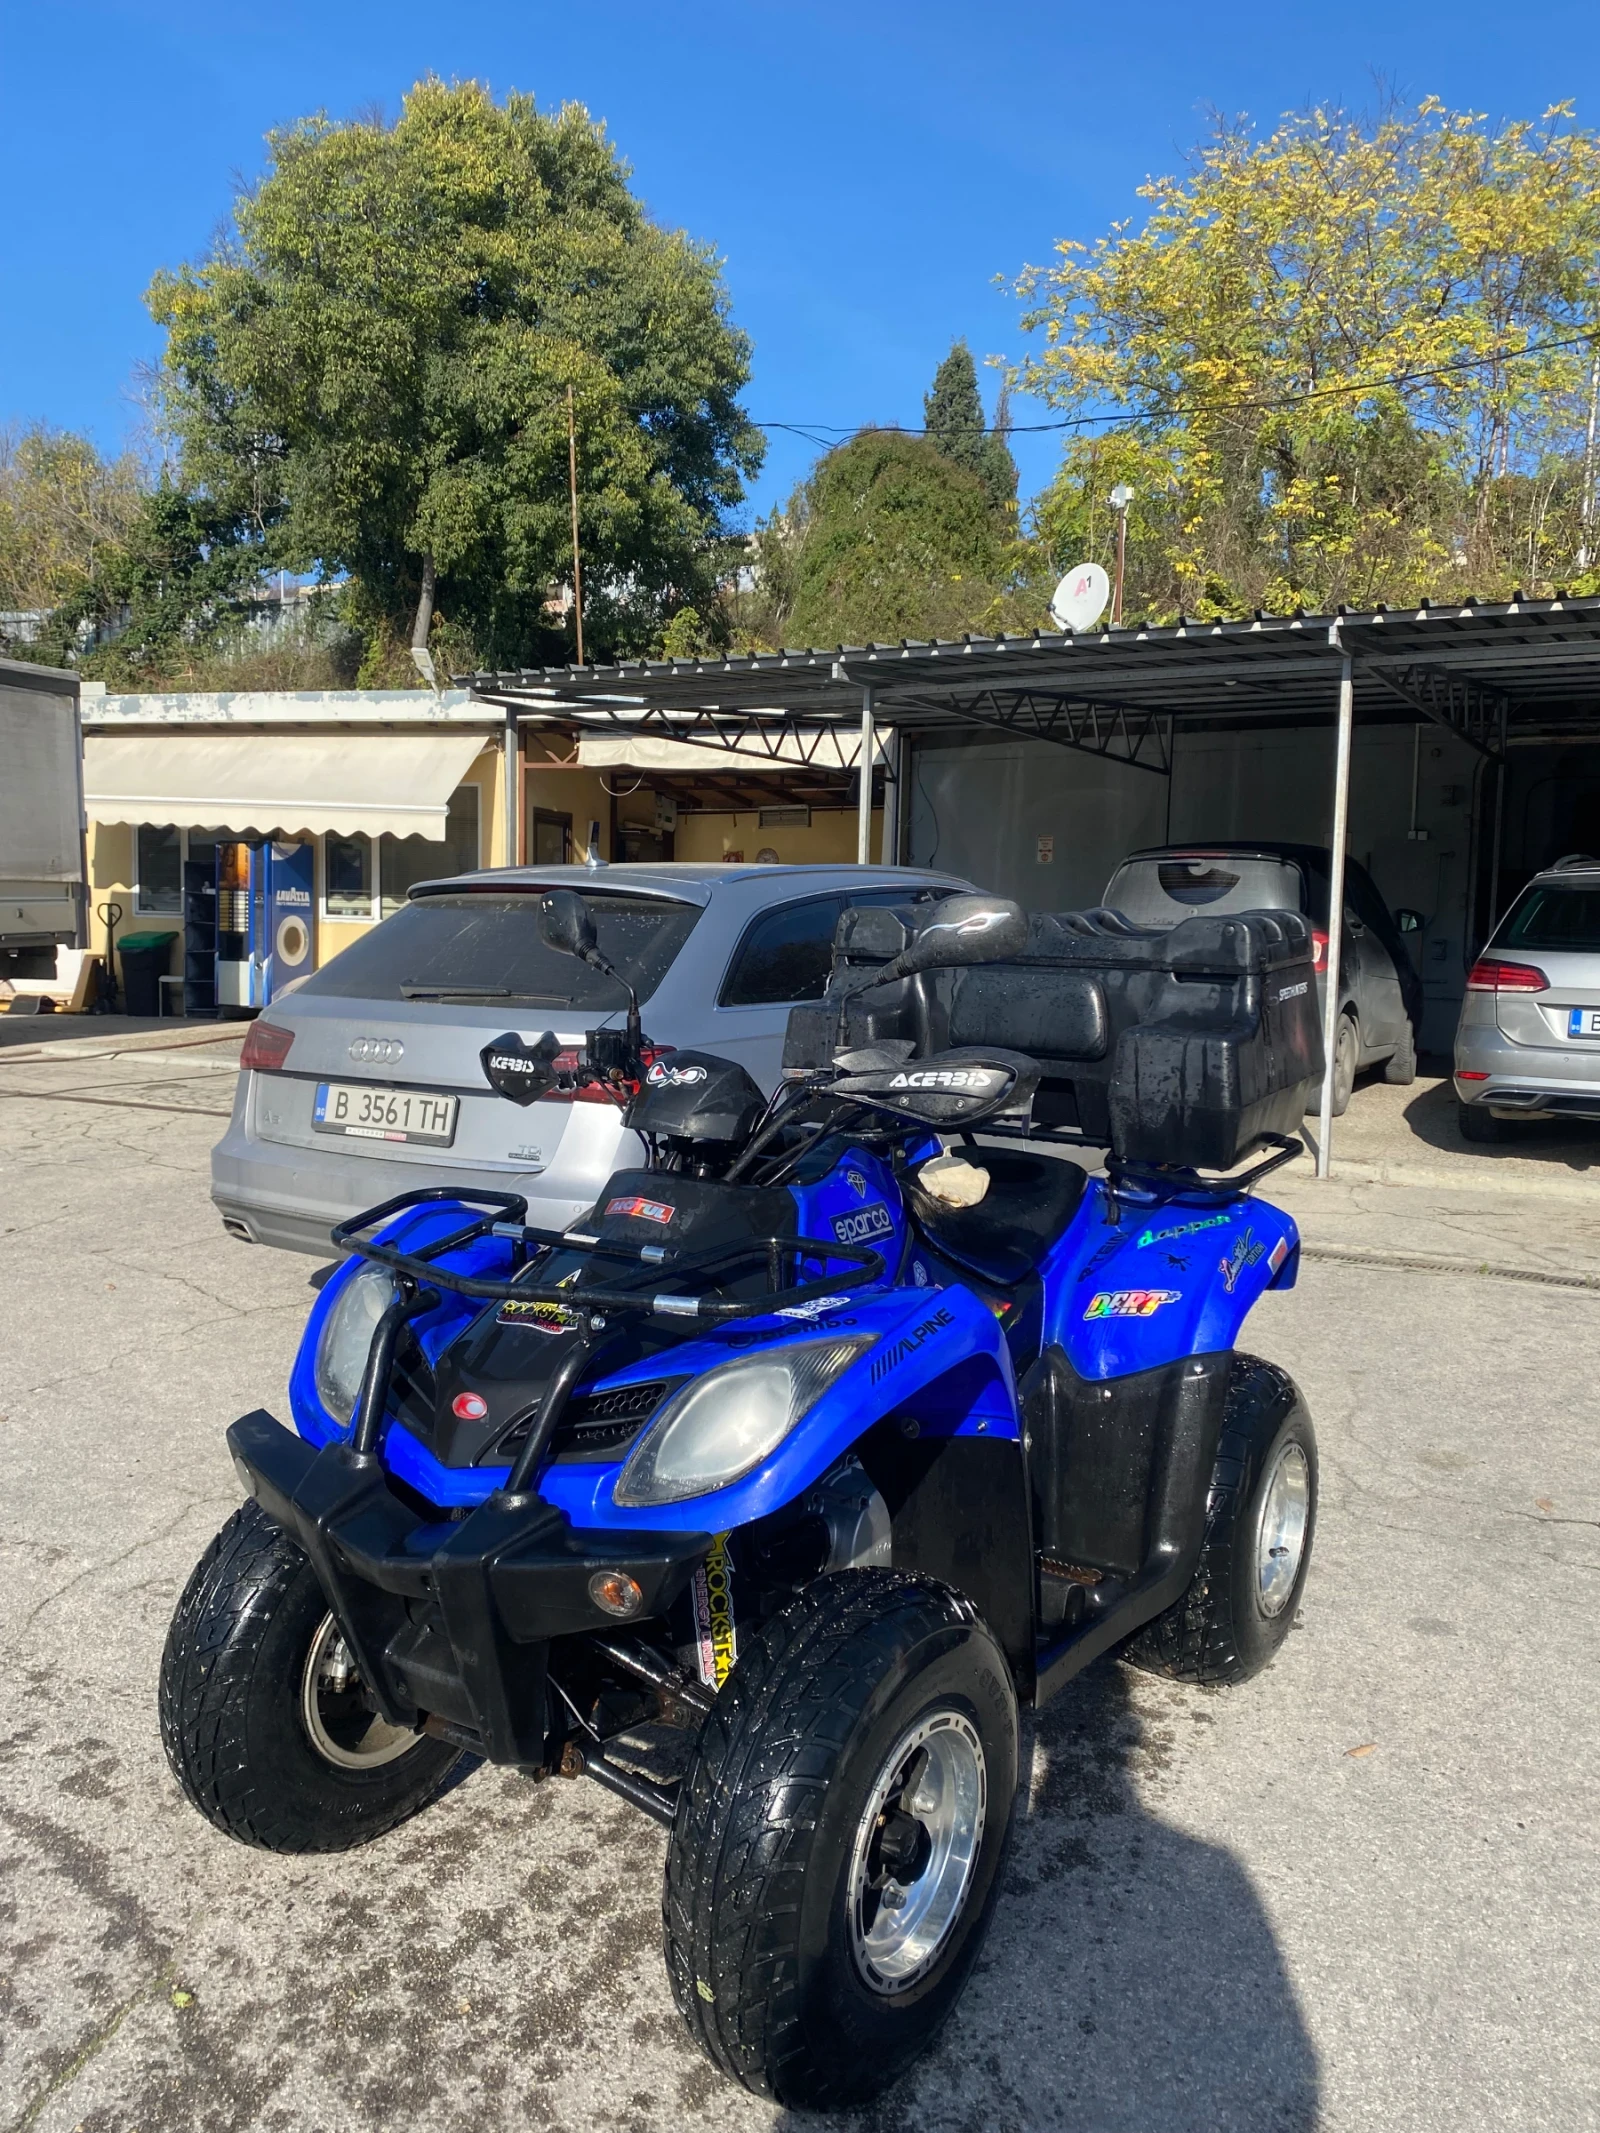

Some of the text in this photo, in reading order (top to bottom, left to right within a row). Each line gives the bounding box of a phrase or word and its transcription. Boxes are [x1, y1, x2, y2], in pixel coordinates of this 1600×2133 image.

[1074, 575, 1092, 597] A1
[276, 887, 310, 902] LAVAZZA
[490, 1056, 535, 1073] ACERBIS
[889, 1071, 992, 1088] ACERBIS
[316, 1107, 325, 1116] BG
[334, 1091, 449, 1131] B 3561 TH
[609, 1200, 667, 1219] MOTUL
[835, 1208, 890, 1245] sparco
[696, 1566, 716, 1678] ENERGY DRINK
